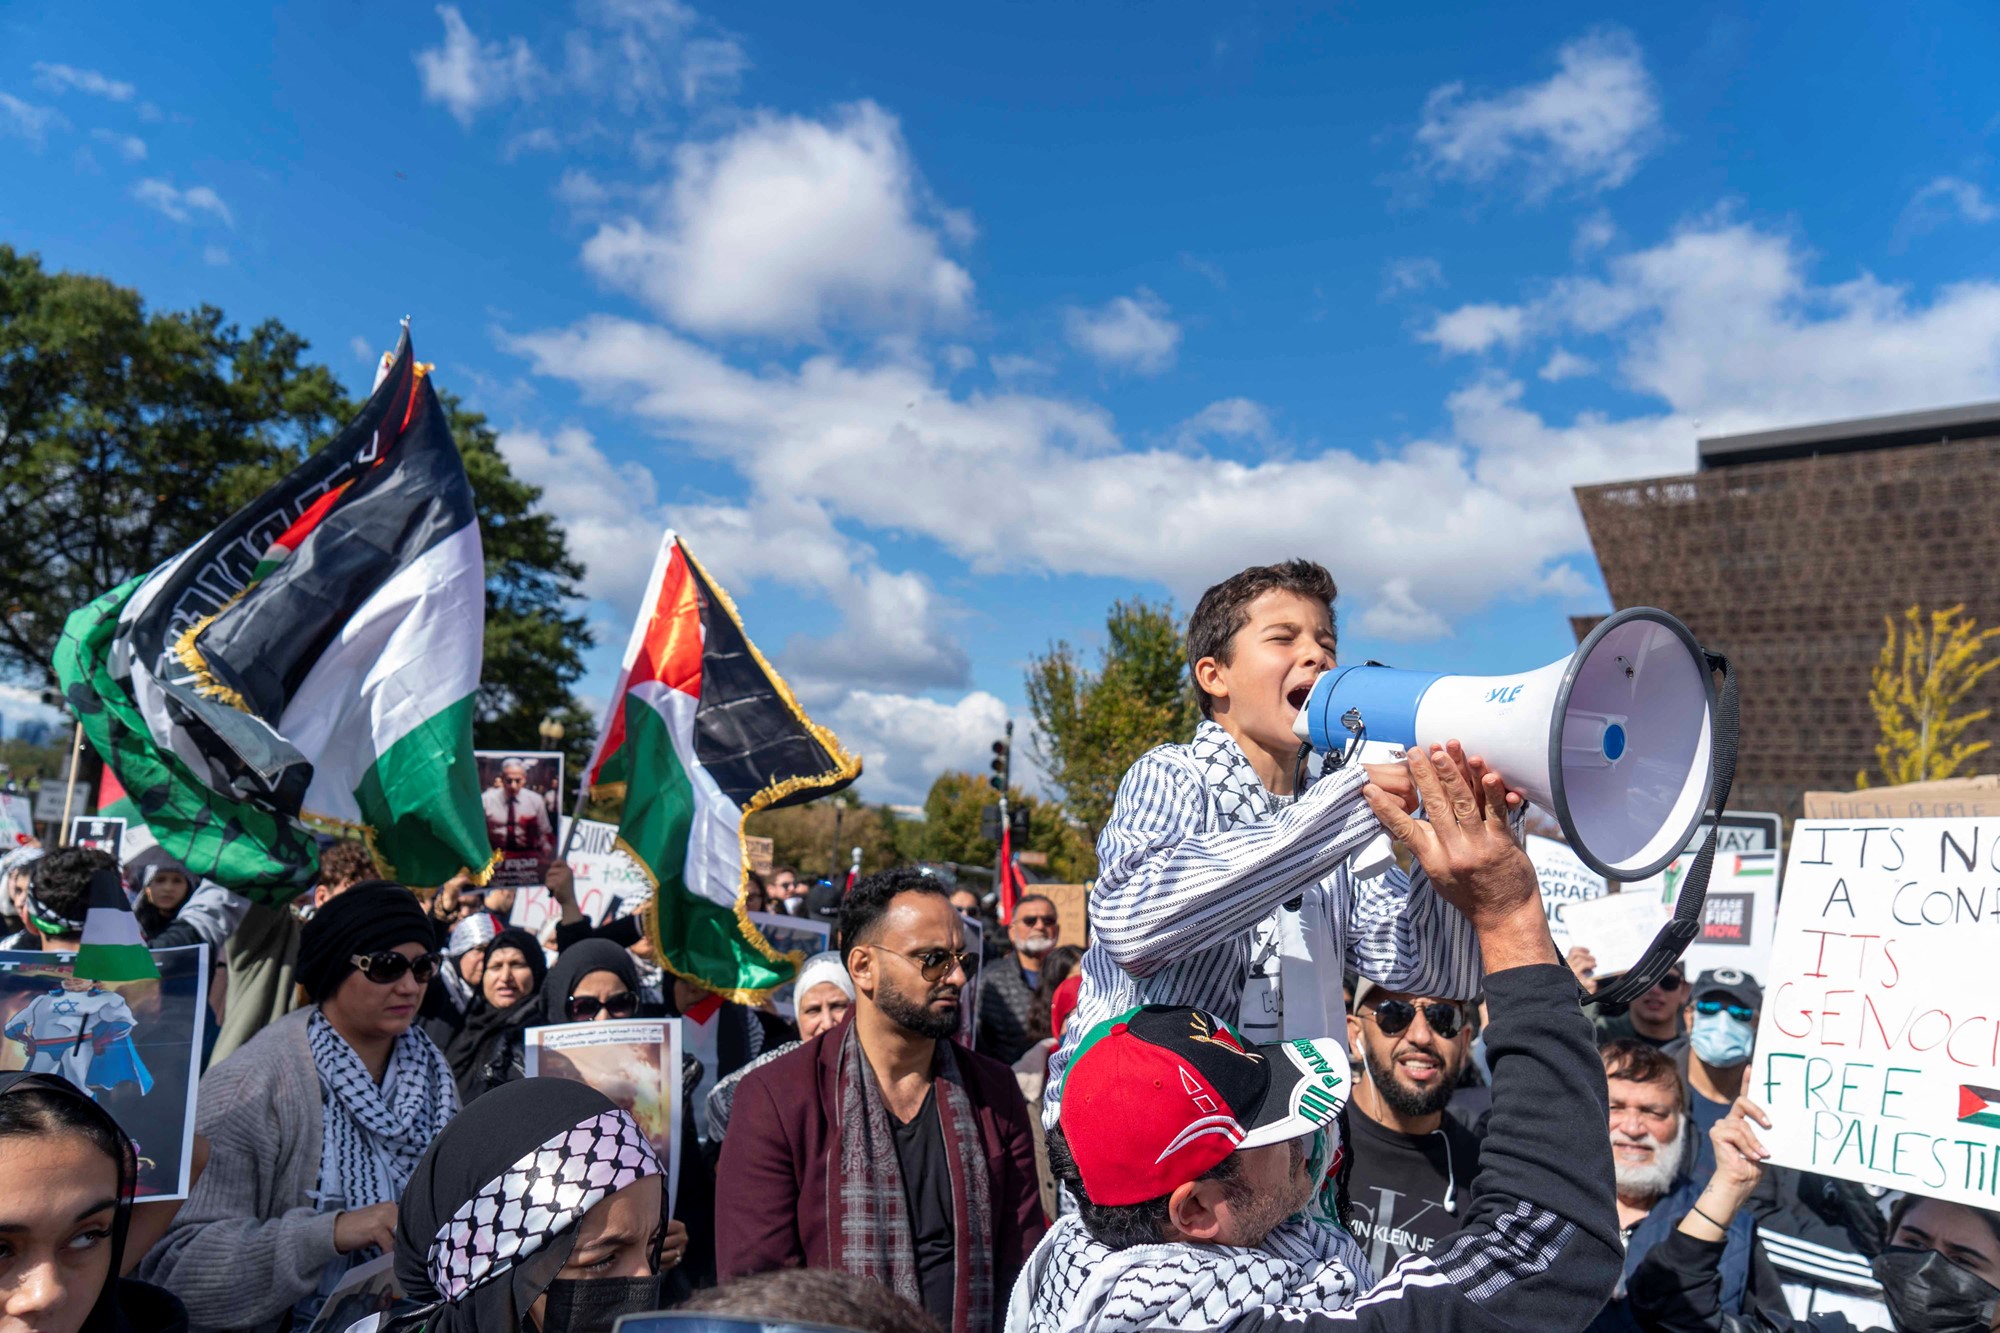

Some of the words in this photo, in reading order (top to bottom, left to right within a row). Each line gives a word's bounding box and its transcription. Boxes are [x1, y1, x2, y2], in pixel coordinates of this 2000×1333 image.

[1485, 684, 1524, 703] YLE
[1800, 827, 1905, 871] ITS
[1541, 880, 1599, 900] SRAE
[1822, 877, 1856, 918] A
[1706, 898, 1743, 911] CEASE
[1705, 910, 1743, 925] FIRE
[1802, 929, 1899, 989] ITS
[1764, 1053, 1927, 1120] FREE
[1373, 1225, 1417, 1249] KLEIN
